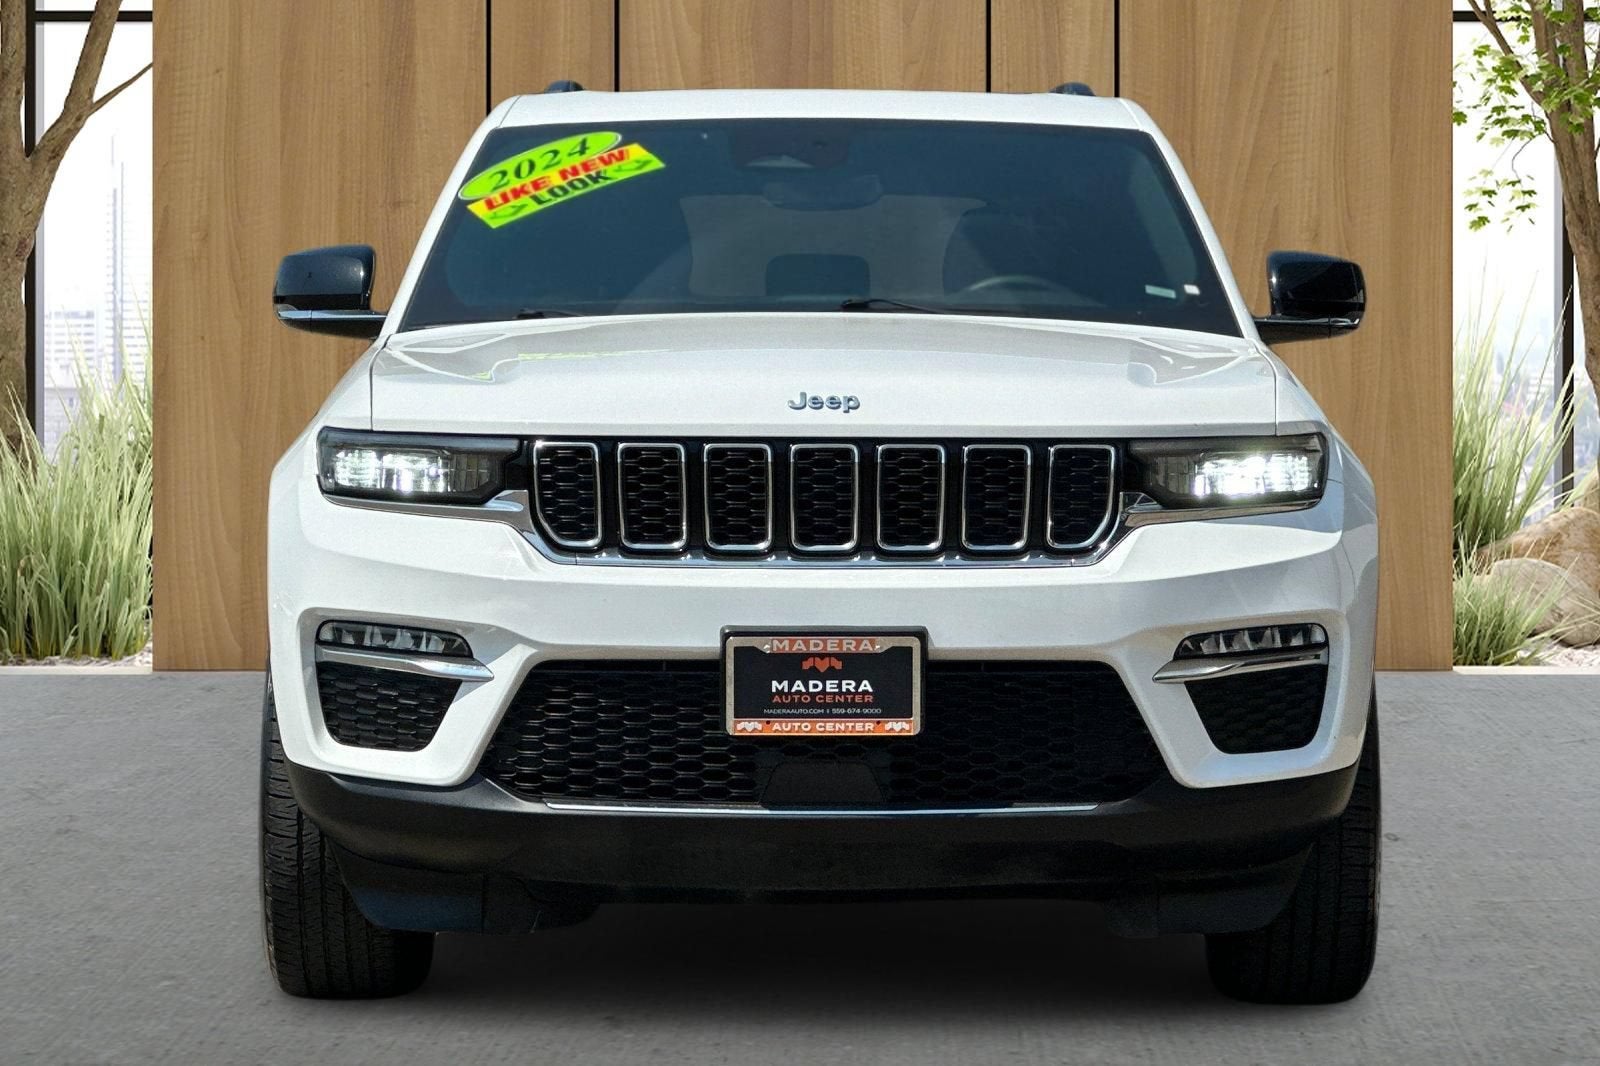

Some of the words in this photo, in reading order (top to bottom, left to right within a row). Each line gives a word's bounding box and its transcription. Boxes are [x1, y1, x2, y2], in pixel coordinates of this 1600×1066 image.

[488, 137, 590, 191] 2024
[484, 176, 552, 211] LIKE
[558, 149, 631, 182] NEW
[529, 170, 613, 206] LOOK
[788, 391, 860, 413] Jeep
[772, 639, 874, 652] MADERA
[771, 680, 874, 693] MADERA
[772, 694, 811, 704] AUTO
[815, 694, 874, 704] CENTER
[772, 722, 812, 732] AUTO
[815, 722, 875, 732] CENTER
